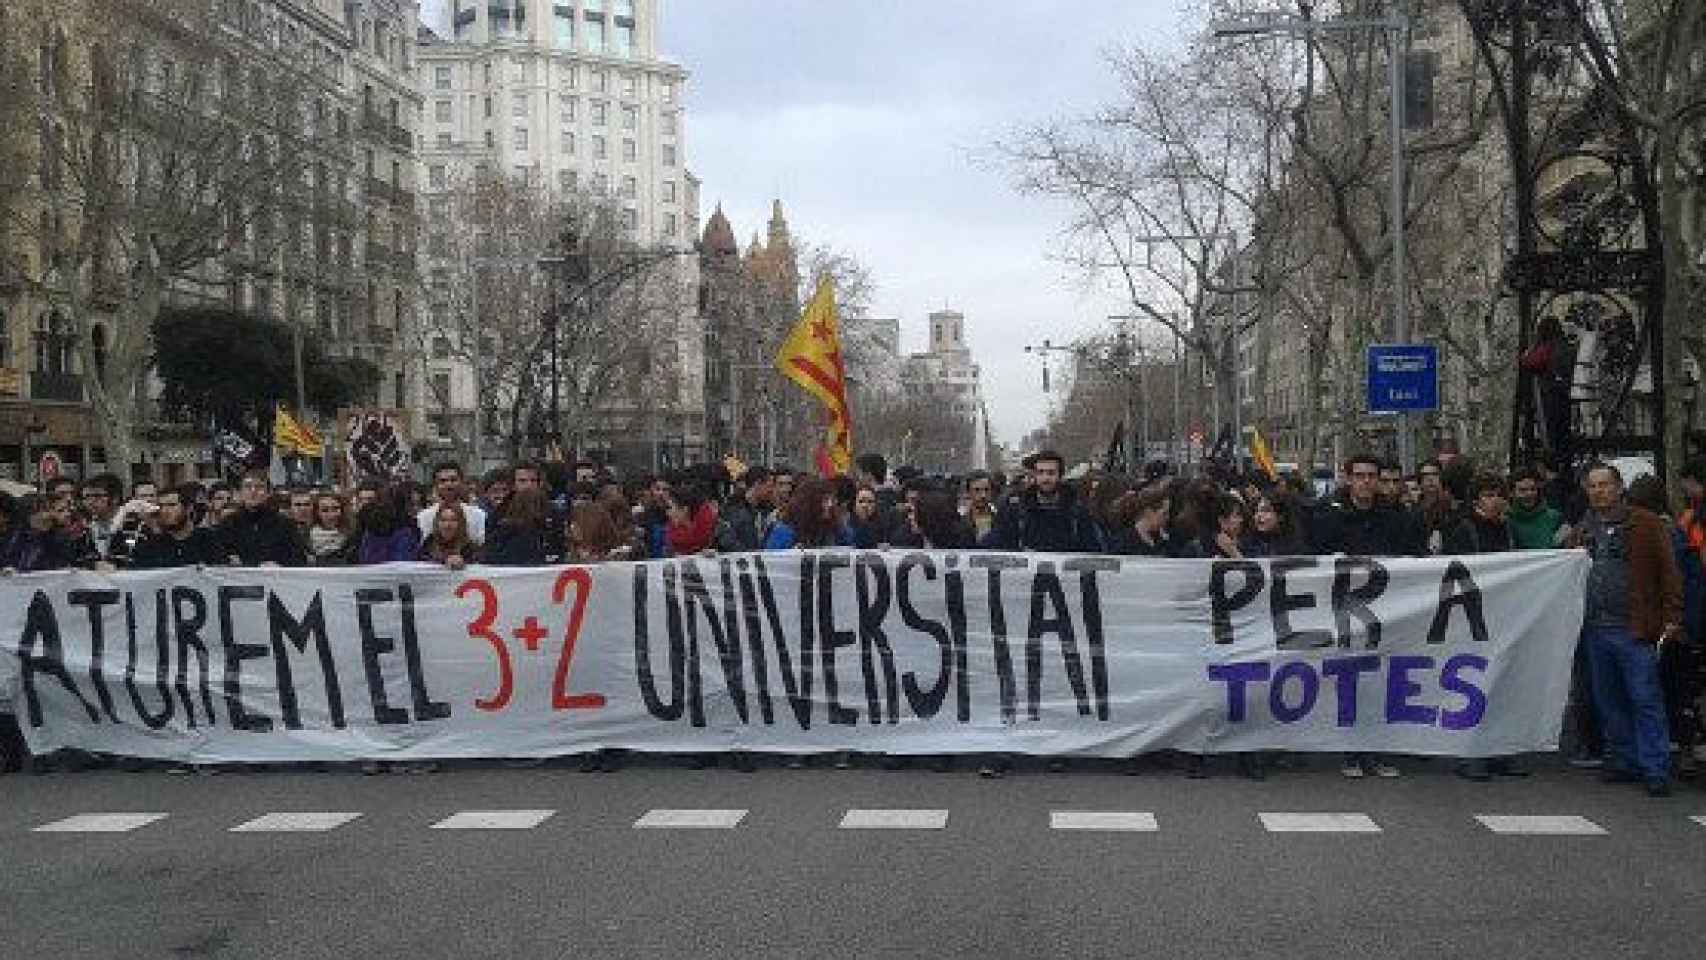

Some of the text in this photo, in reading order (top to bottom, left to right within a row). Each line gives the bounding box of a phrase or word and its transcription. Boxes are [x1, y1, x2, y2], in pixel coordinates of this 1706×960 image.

[17, 584, 347, 732] ATUREM
[354, 582, 452, 725] EL
[455, 567, 606, 713] 3+2
[1208, 556, 1391, 650] PER
[1426, 560, 1489, 645] A
[1208, 654, 1490, 730] TOTES
